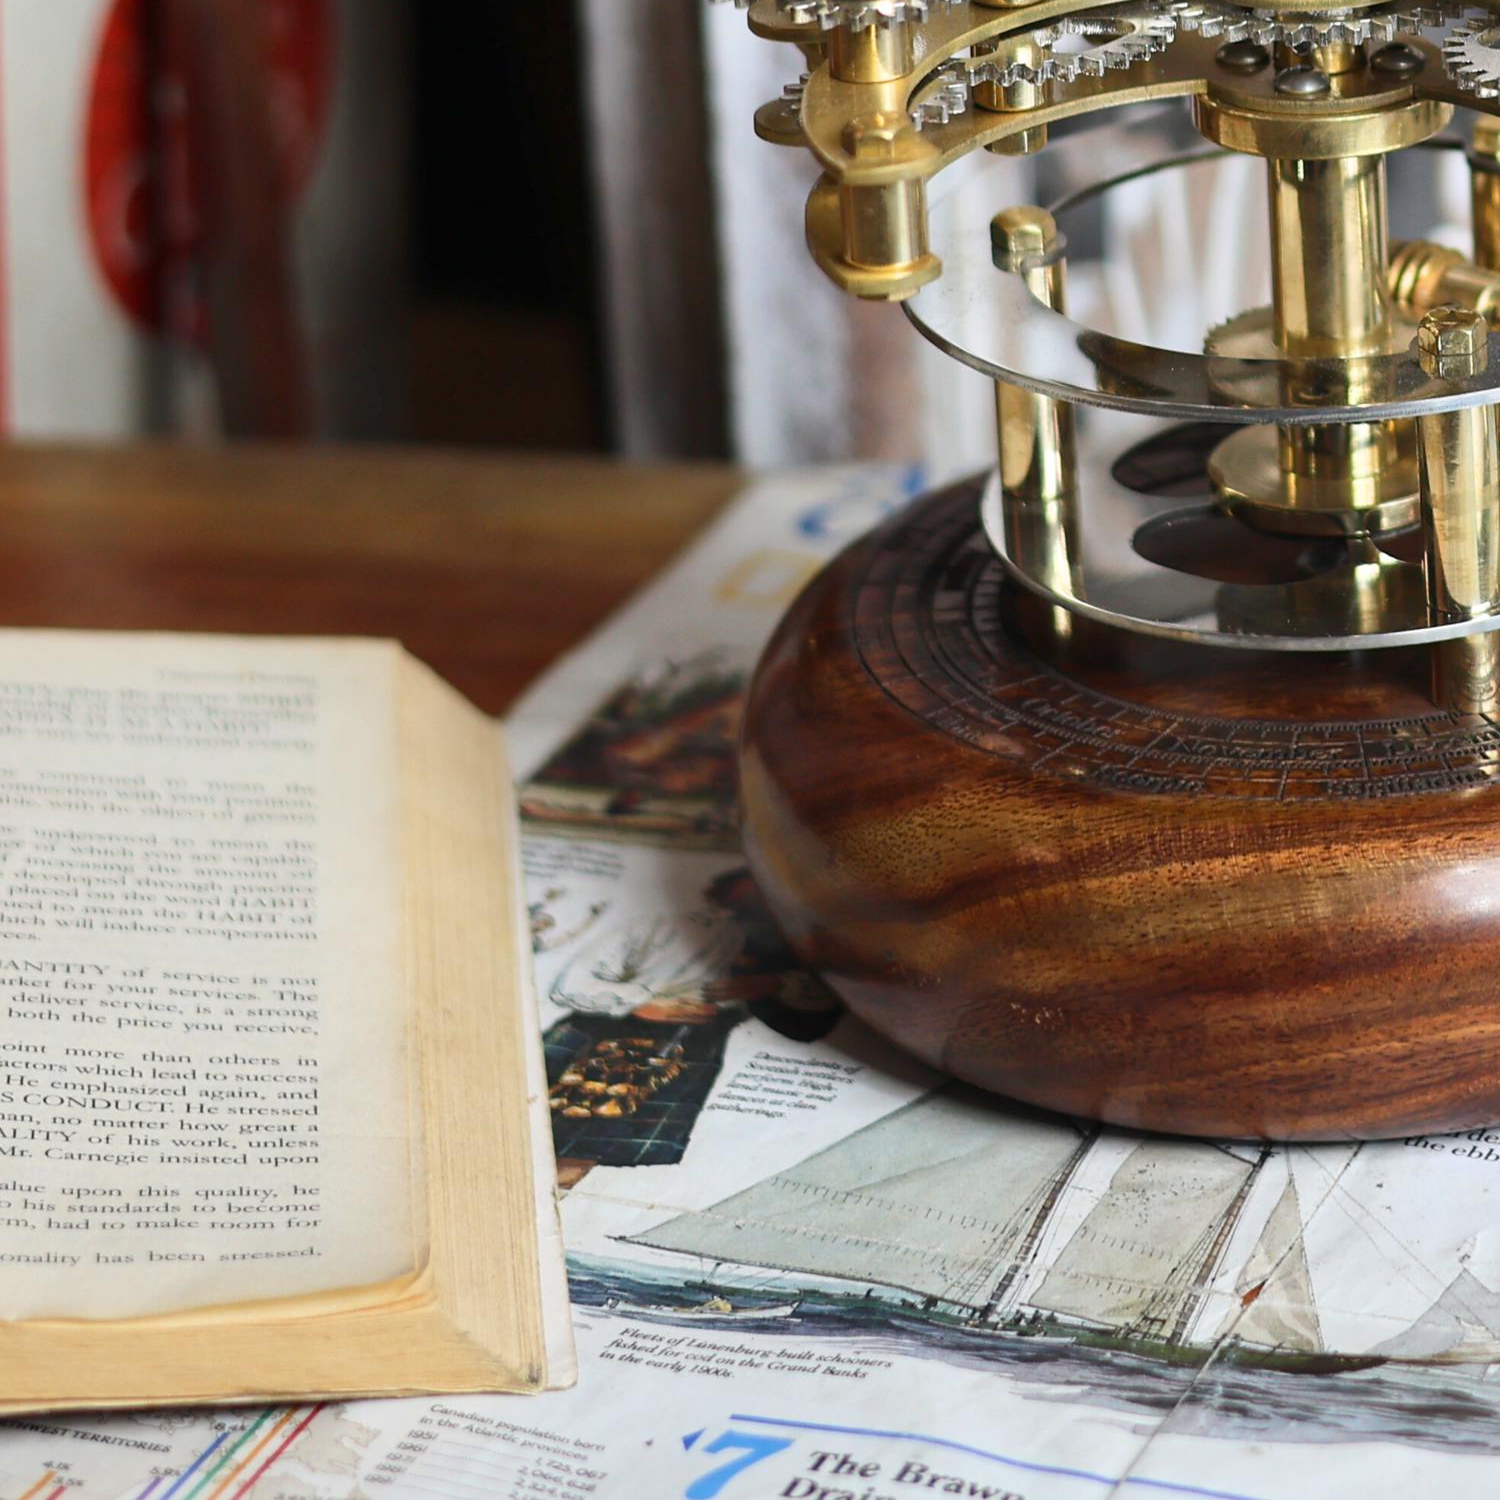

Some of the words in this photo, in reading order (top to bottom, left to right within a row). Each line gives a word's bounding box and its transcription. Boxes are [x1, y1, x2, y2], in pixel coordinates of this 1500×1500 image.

[66, 1047, 125, 1060] more
[143, 1053, 192, 1063] than
[209, 1054, 280, 1066] others
[298, 1055, 318, 1066] in
[76, 1064, 143, 1079] which
[152, 1068, 197, 1080] lead
[206, 1071, 226, 1081] to
[235, 1073, 319, 1083] success
[6, 1075, 39, 1087] He
[50, 1079, 188, 1096] emphasized
[199, 1089, 266, 1101] again,
[278, 1090, 318, 1099] and
[23, 1094, 174, 1113] CONDUCT.
[186, 1103, 219, 1114] He
[228, 1106, 318, 1116] stressed
[52, 1116, 81, 1125] no
[93, 1118, 169, 1129] matter
[180, 1121, 228, 1131] how
[239, 1123, 297, 1135] great
[88, 1134, 114, 1145] of
[128, 1135, 159, 1146] his
[172, 1137, 237, 1149] work,
[248, 1139, 319, 1148] unless
[1403, 1136, 1445, 1152] the
[1451, 1145, 1500, 1162] ebb
[45, 1149, 149, 1165] Carnegie
[160, 1152, 248, 1164] insisted
[259, 1156, 319, 1167] upon
[61, 1187, 122, 1198] upon
[138, 1186, 180, 1197] this
[195, 1186, 278, 1200] quality,
[294, 1186, 320, 1196] he
[24, 1200, 56, 1211] his
[67, 1202, 181, 1213] standards
[193, 1203, 215, 1213] to
[228, 1202, 320, 1213] become
[48, 1218, 89, 1230] had
[102, 1220, 125, 1230] to
[136, 1218, 199, 1229] make
[209, 1219, 274, 1228] room
[287, 1218, 322, 1228] for
[96, 1252, 133, 1263] has
[150, 1251, 205, 1261] been
[220, 1248, 322, 1261] stressed.
[608, 1339, 660, 1355] fished
[657, 1347, 681, 1359] for
[684, 1352, 713, 1362] cod
[716, 1357, 735, 1366] on
[739, 1357, 762, 1370] the
[766, 1360, 818, 1373] Grand
[820, 1365, 870, 1380] Banks
[620, 1328, 664, 1342] Fleets
[666, 1336, 687, 1347] of
[816, 1352, 894, 1369] schooners
[599, 1351, 615, 1361] in
[618, 1353, 643, 1364] the
[644, 1358, 685, 1373] early
[420, 1415, 433, 1425] in
[437, 1418, 460, 1429] the
[462, 1424, 517, 1443] Atlantic
[520, 1438, 588, 1462] provinces
[430, 1403, 494, 1426] Canadian
[497, 1421, 570, 1444] population
[574, 1437, 606, 1452] born
[71, 1428, 173, 1453] TERRITORIES
[684, 1430, 796, 1500] 7
[805, 1450, 881, 1478] The
